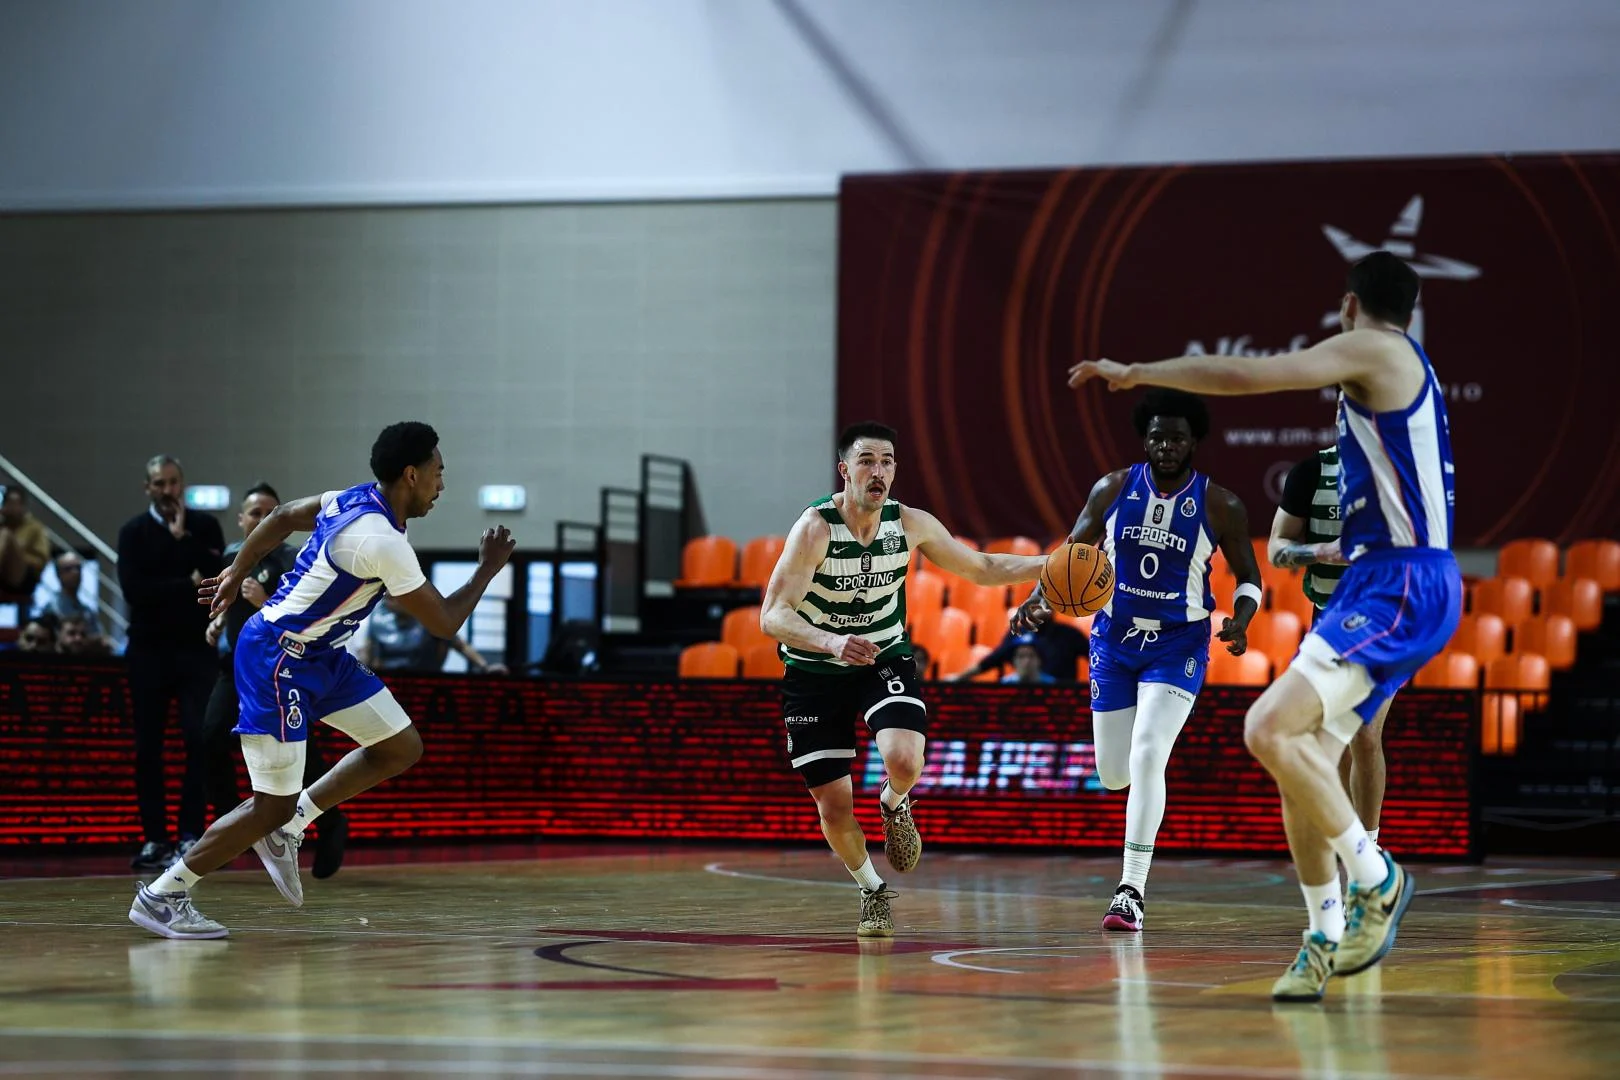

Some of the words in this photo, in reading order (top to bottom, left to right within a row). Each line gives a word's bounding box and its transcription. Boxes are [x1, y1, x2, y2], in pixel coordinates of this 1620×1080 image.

[1140, 552, 1160, 580] 0
[834, 572, 894, 591] SPORTING
[1118, 582, 1166, 600] GLASSDRIVE
